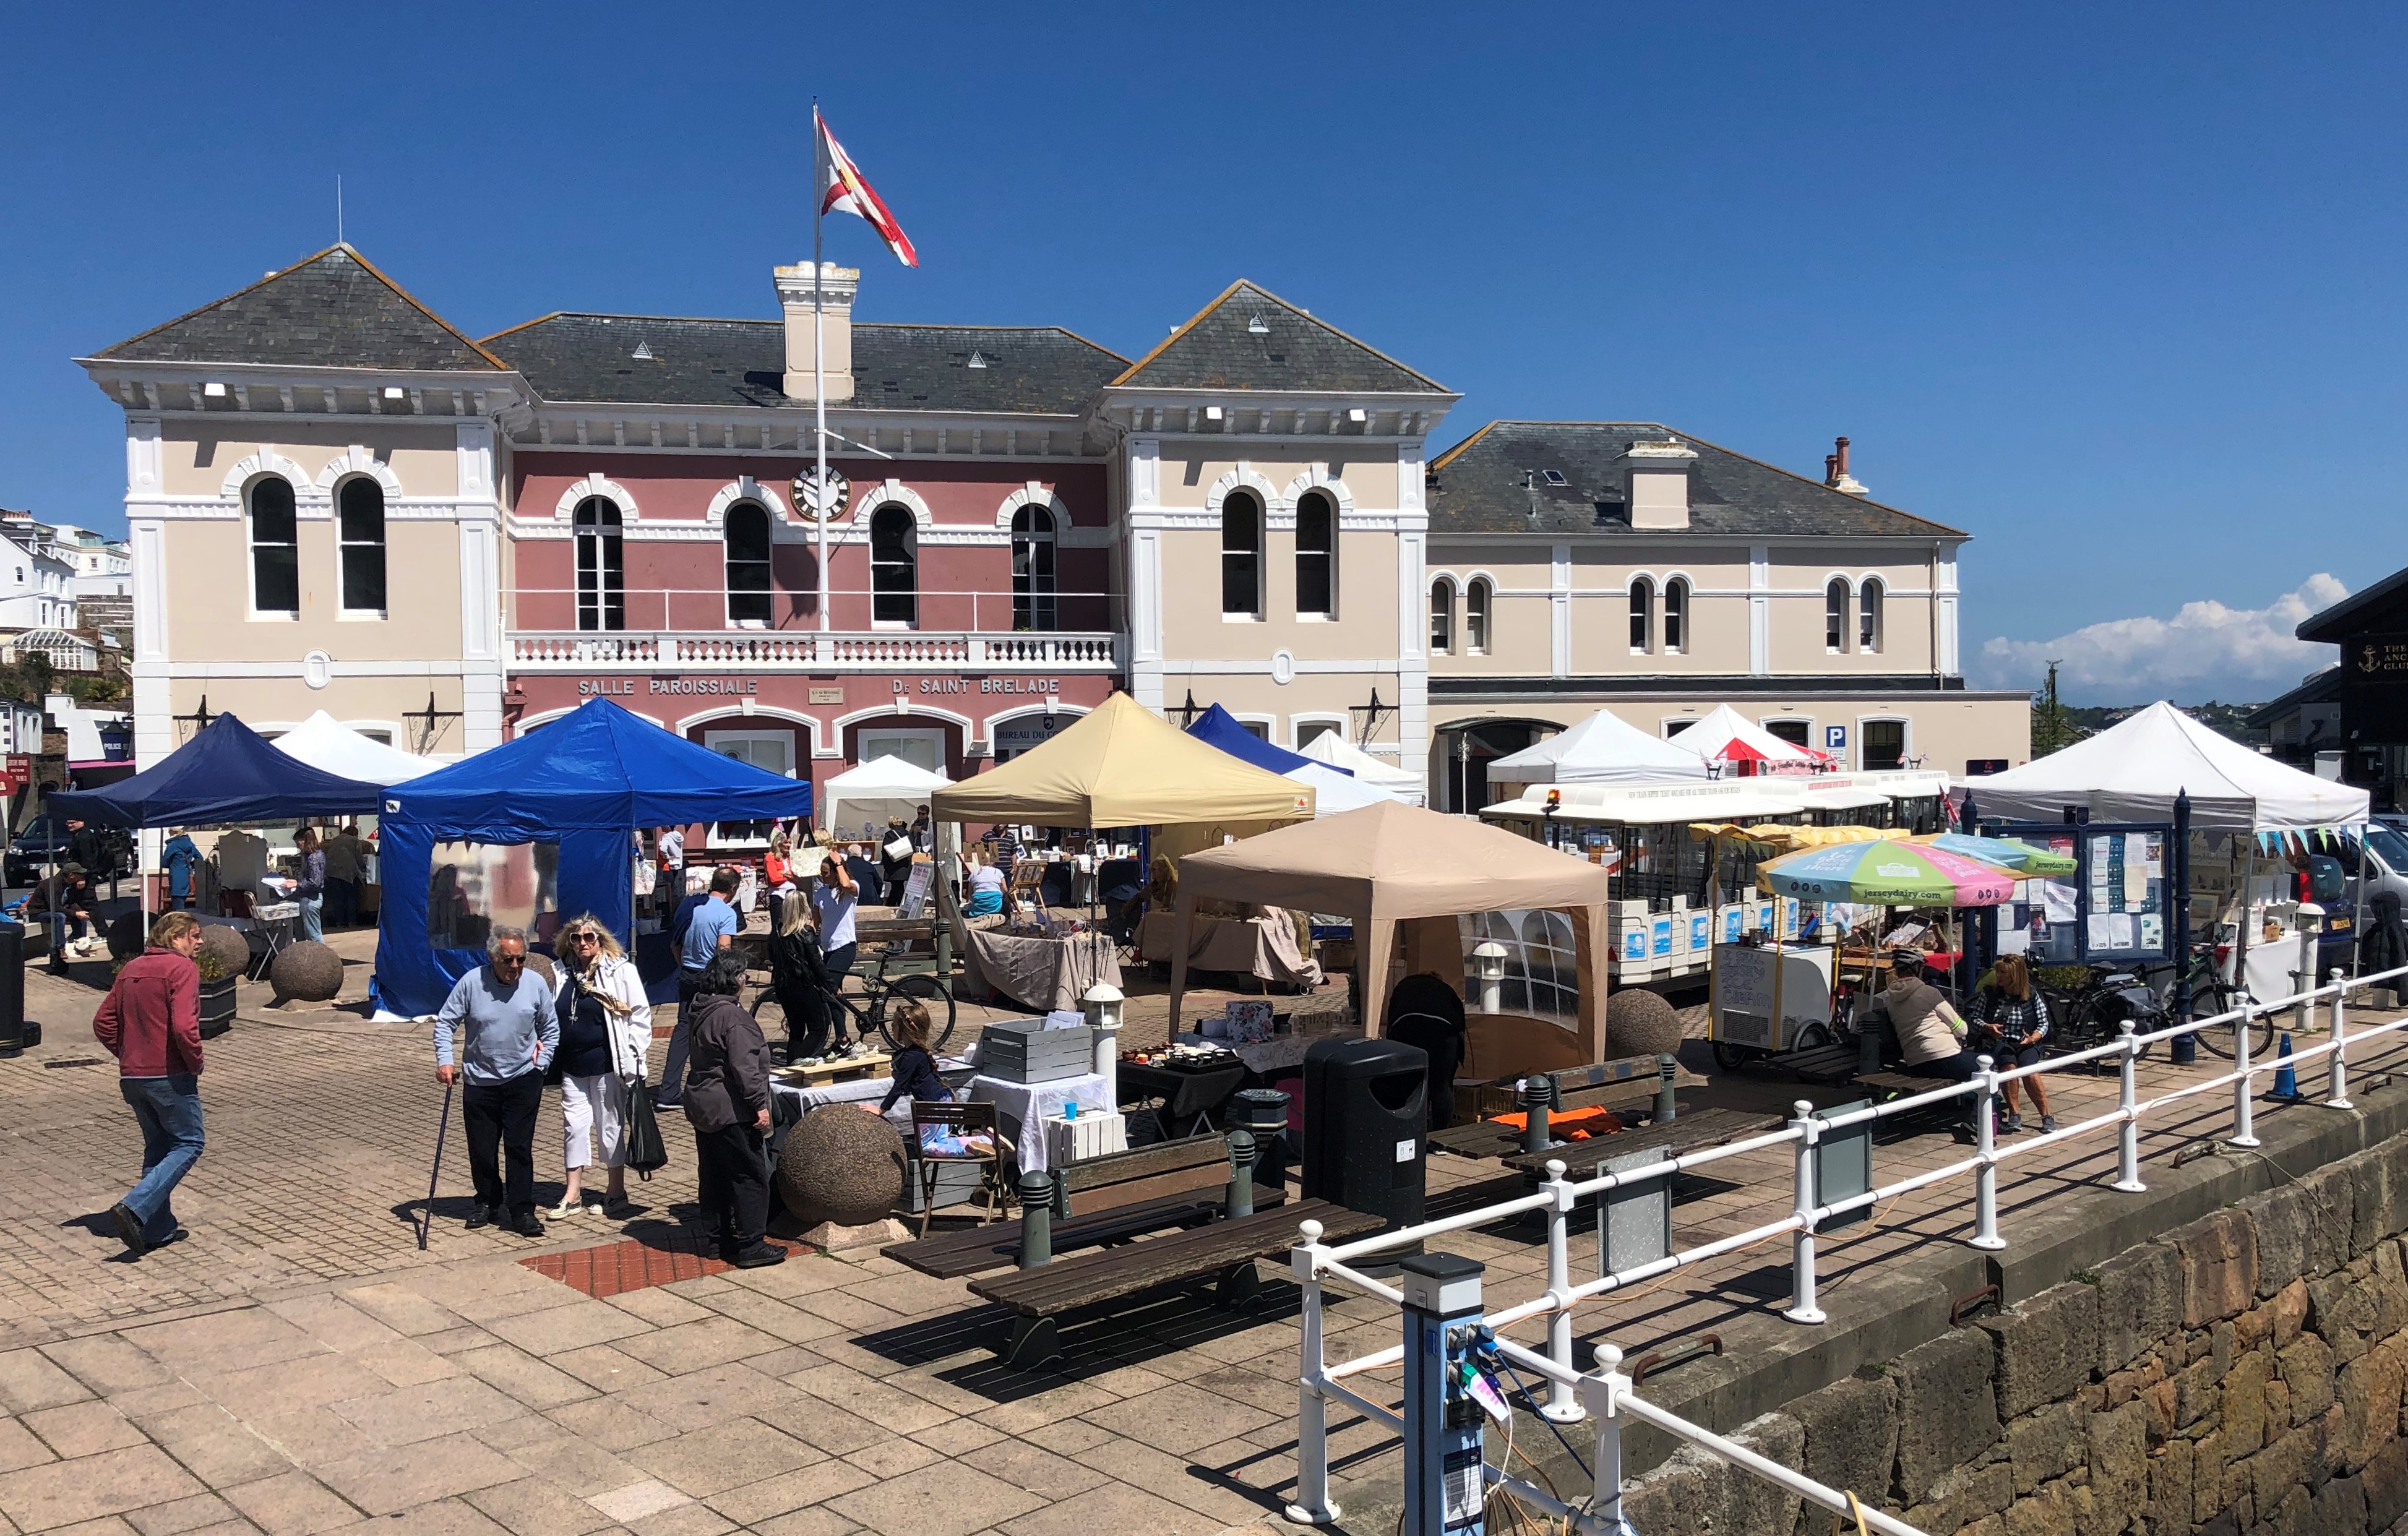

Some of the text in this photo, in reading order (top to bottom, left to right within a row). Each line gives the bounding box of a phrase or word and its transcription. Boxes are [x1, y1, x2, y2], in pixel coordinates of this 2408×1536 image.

[578, 679, 758, 695] SALLE PAROISSIALE
[919, 679, 970, 695] SAINT
[980, 679, 1059, 695] BRELADE
[997, 731, 1030, 739] BUREAU
[1830, 728, 1843, 747] P
[1863, 888, 1941, 899] jerseydairy.com
[1723, 989, 1772, 1009] CREAM
